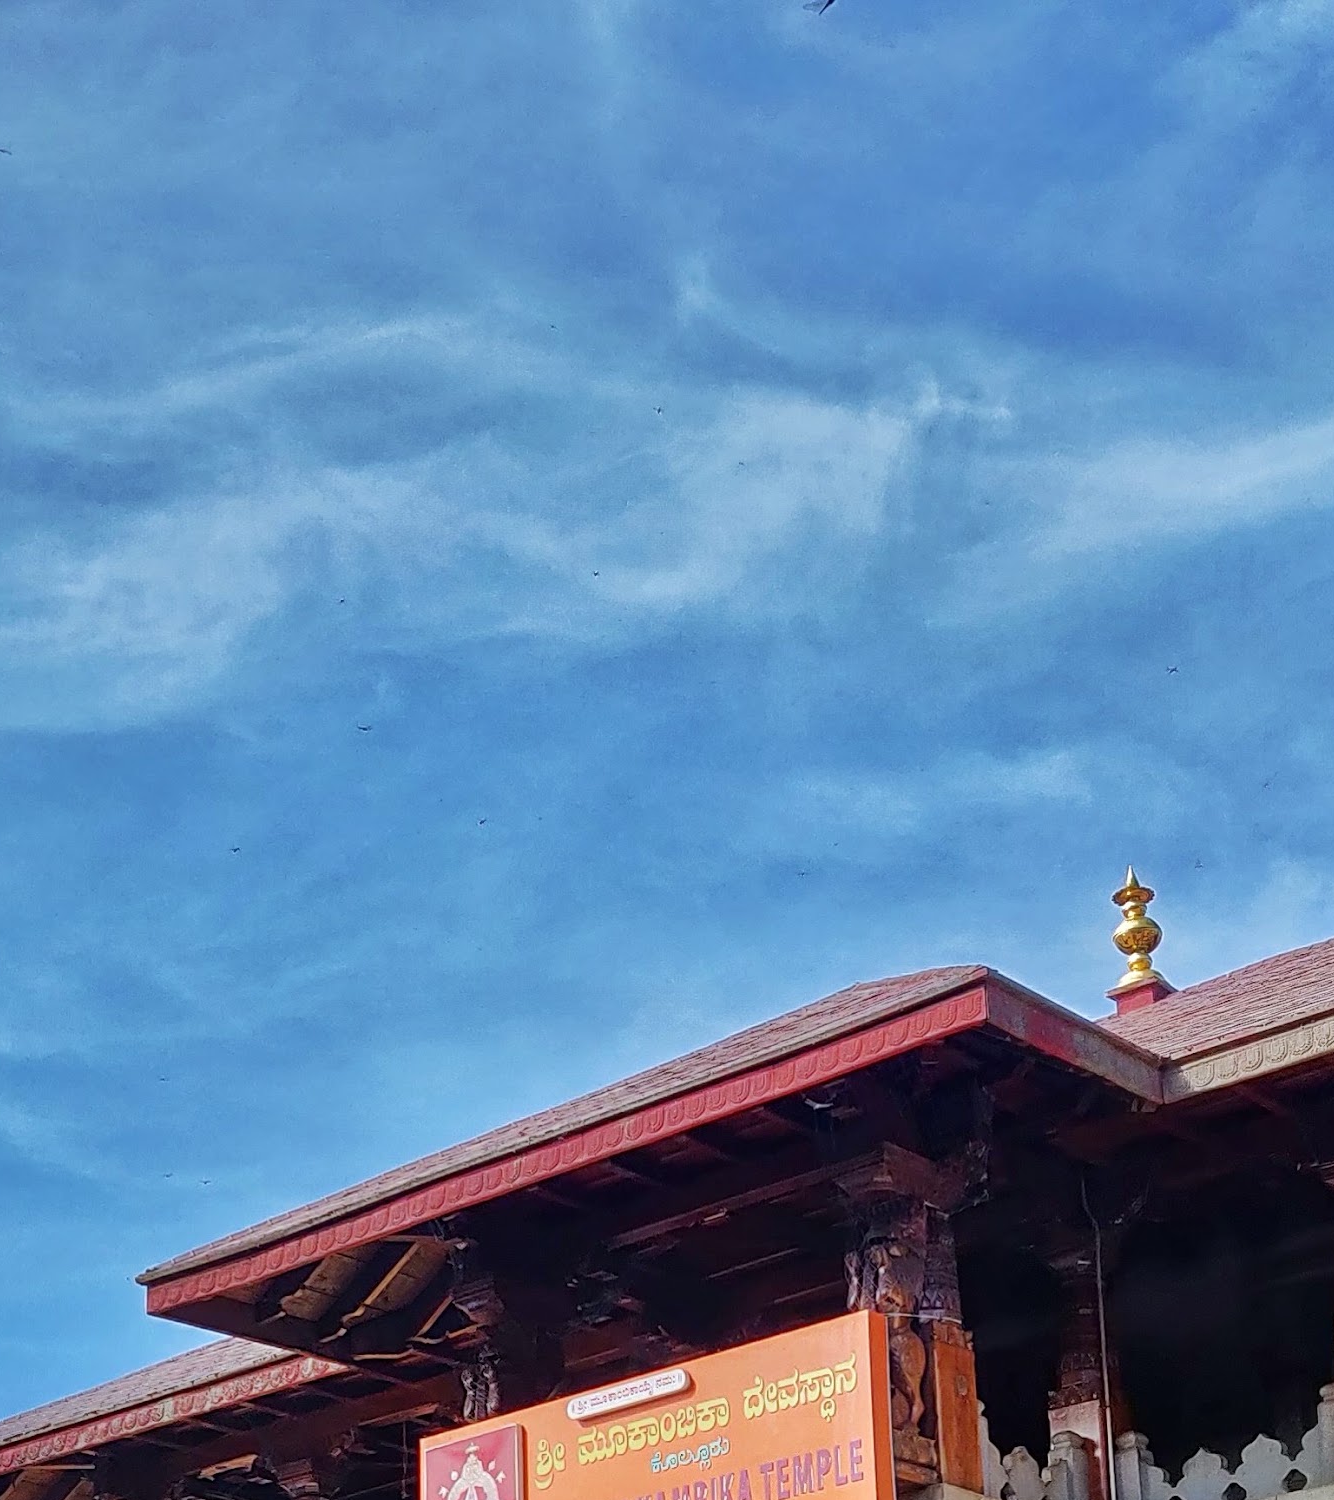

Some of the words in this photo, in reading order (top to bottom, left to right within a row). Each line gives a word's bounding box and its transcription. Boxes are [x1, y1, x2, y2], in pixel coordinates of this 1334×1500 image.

[534, 1438, 566, 1490] ಶ್ರೀ
[577, 1397, 731, 1466] ಮೂಕಾಂಬಿಕಾ
[743, 1353, 858, 1423] ದೇವಸ್ಥಾನ
[650, 1435, 731, 1473] ಕೊಲ್ಲೂರು
